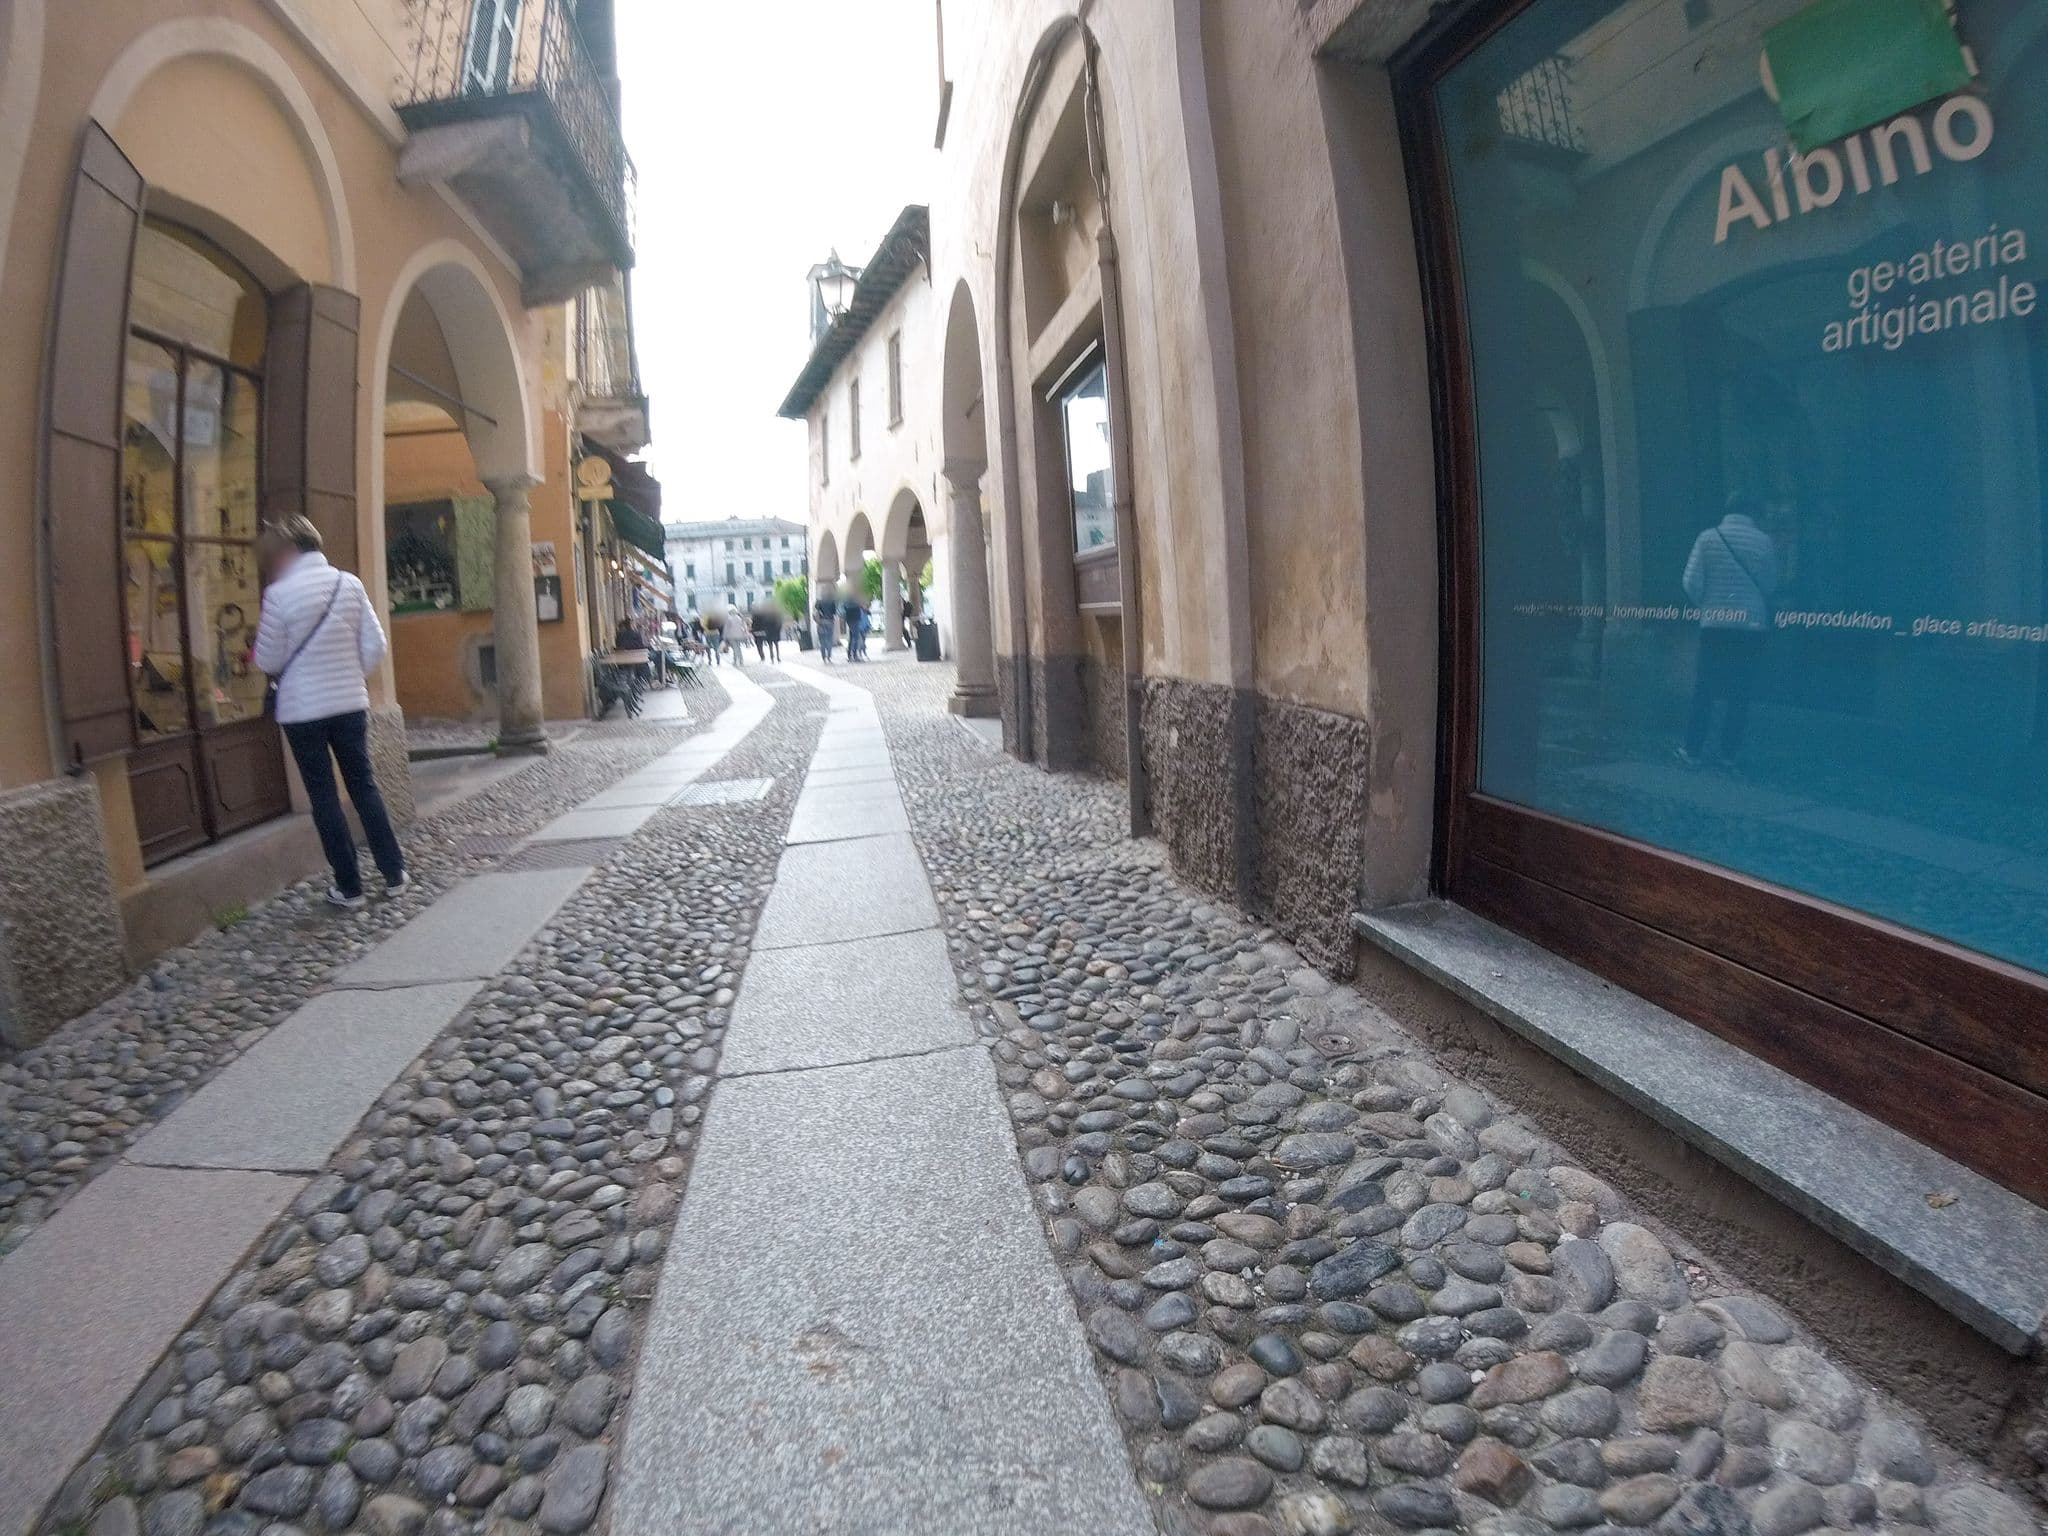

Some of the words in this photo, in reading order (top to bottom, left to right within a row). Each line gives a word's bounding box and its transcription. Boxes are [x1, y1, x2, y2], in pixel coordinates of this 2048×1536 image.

[1714, 95, 1994, 245] Albino
[1821, 275, 2037, 352] artigianale
[1612, 604, 1679, 620] homemade
[1682, 603, 1701, 620] ice
[1702, 607, 1747, 621] cream
[1774, 609, 1893, 630] igenproduktion
[1912, 615, 1962, 637] glace
